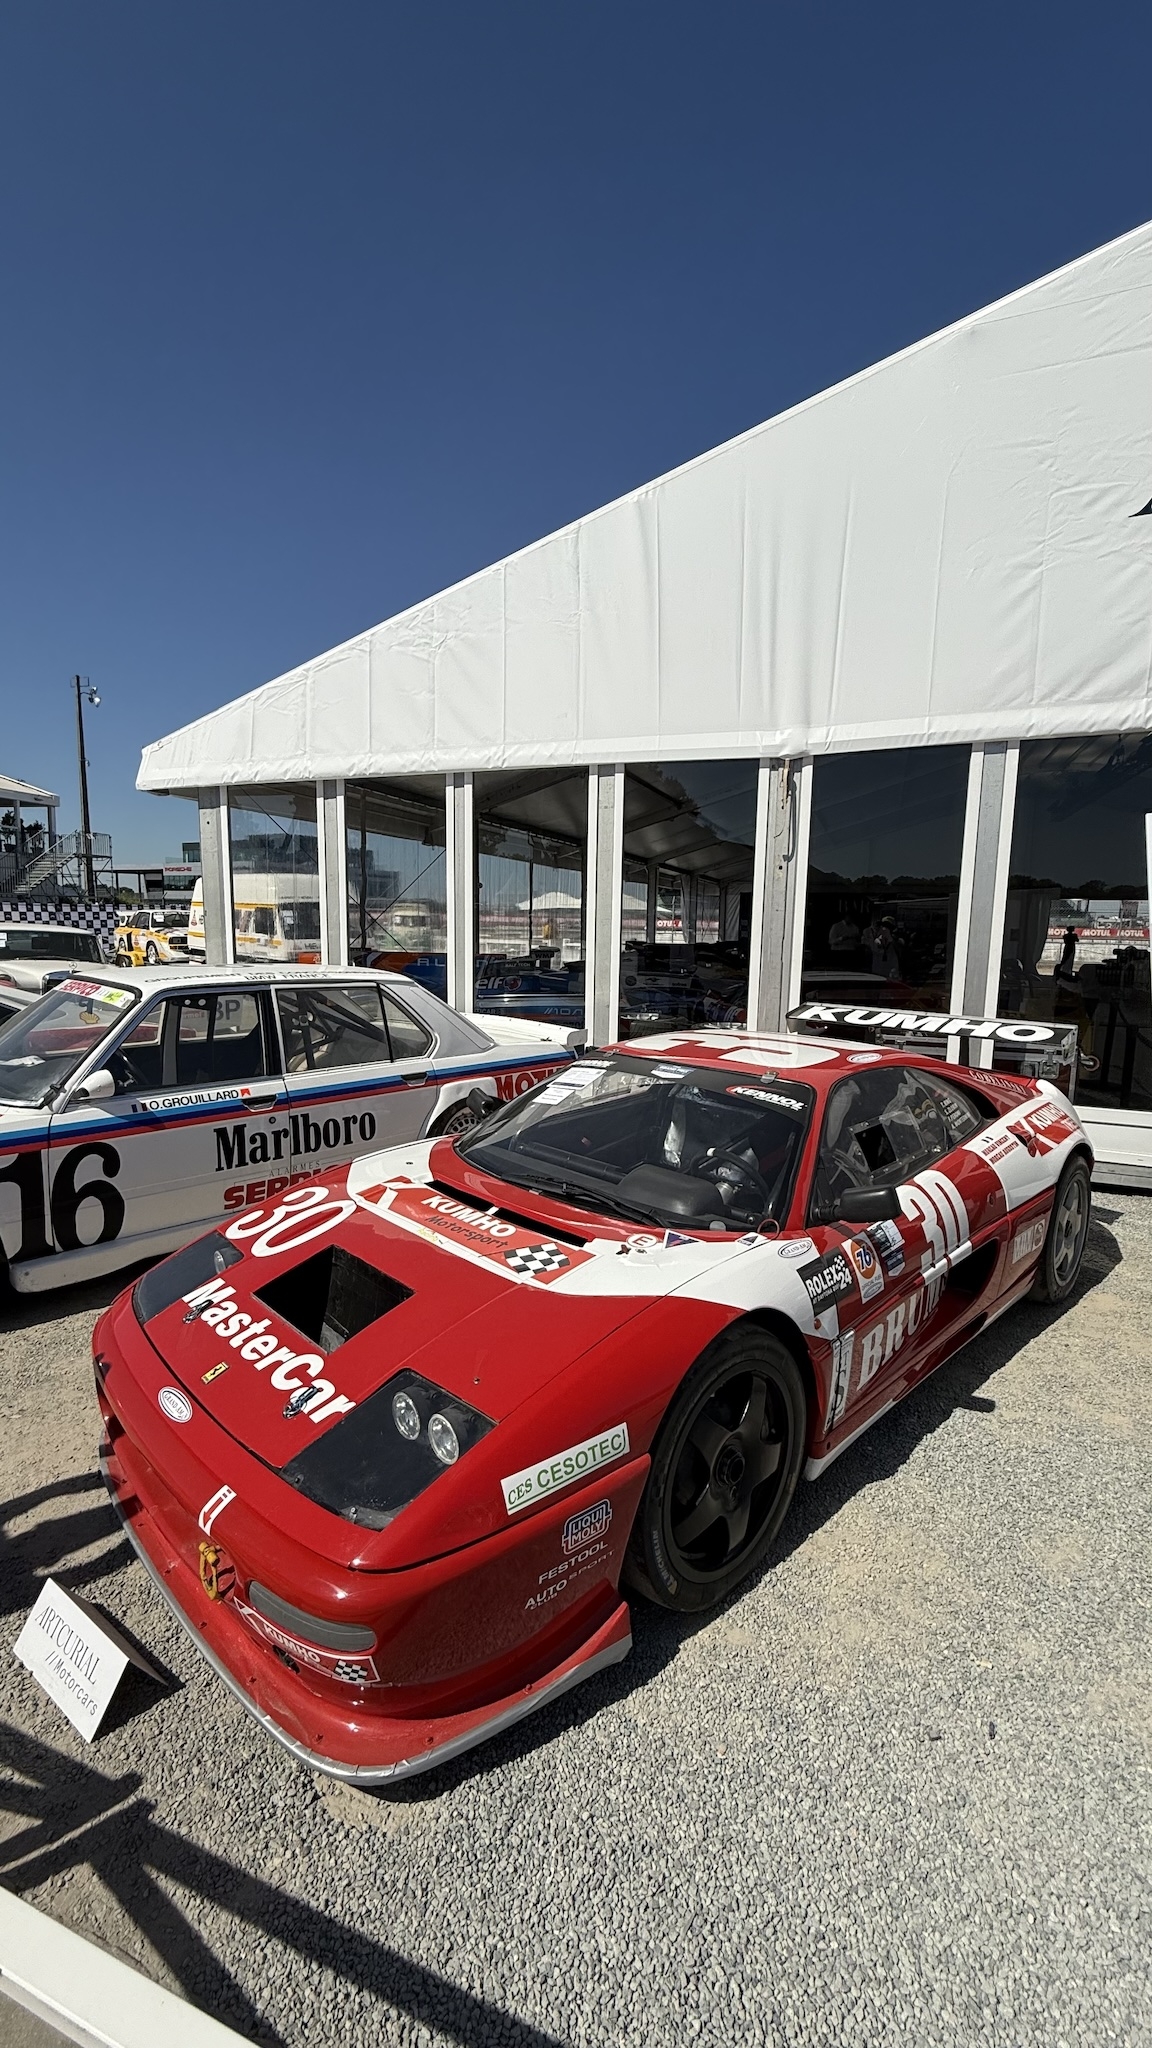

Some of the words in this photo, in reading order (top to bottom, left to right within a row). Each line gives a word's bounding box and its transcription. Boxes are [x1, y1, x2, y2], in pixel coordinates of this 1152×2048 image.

[1081, 928, 1111, 937] MOTUL
[475, 977, 504, 990] elf
[799, 1005, 1055, 1042] KUMHO
[149, 1089, 239, 1111] O.GROUILLARD
[732, 1086, 805, 1110] KENNOL
[213, 1112, 376, 1172] Marlboro
[268, 1160, 321, 1178] ALARMES
[0, 1141, 125, 1262] 16
[421, 1195, 517, 1237] KUMHO
[225, 1186, 357, 1257] 30
[425, 1215, 509, 1248] Motorsport
[895, 1169, 971, 1287] 30
[633, 1236, 652, 1246] E
[855, 1243, 874, 1272] 76
[805, 1263, 838, 1298] ROLEX
[838, 1267, 852, 1290] 24
[508, 1478, 533, 1505] CES
[536, 1433, 623, 1488] CESOTEC
[571, 1520, 602, 1545] MOLY
[573, 1508, 603, 1533] LIQUI
[538, 1541, 608, 1585] FESTOOL
[652, 1530, 669, 1580] MICHELIN
[525, 1579, 567, 1610] AUTO
[568, 1550, 615, 1580] SPORT
[35, 1606, 100, 1685] ARTCURIAL
[263, 1623, 321, 1663] KUMHO
